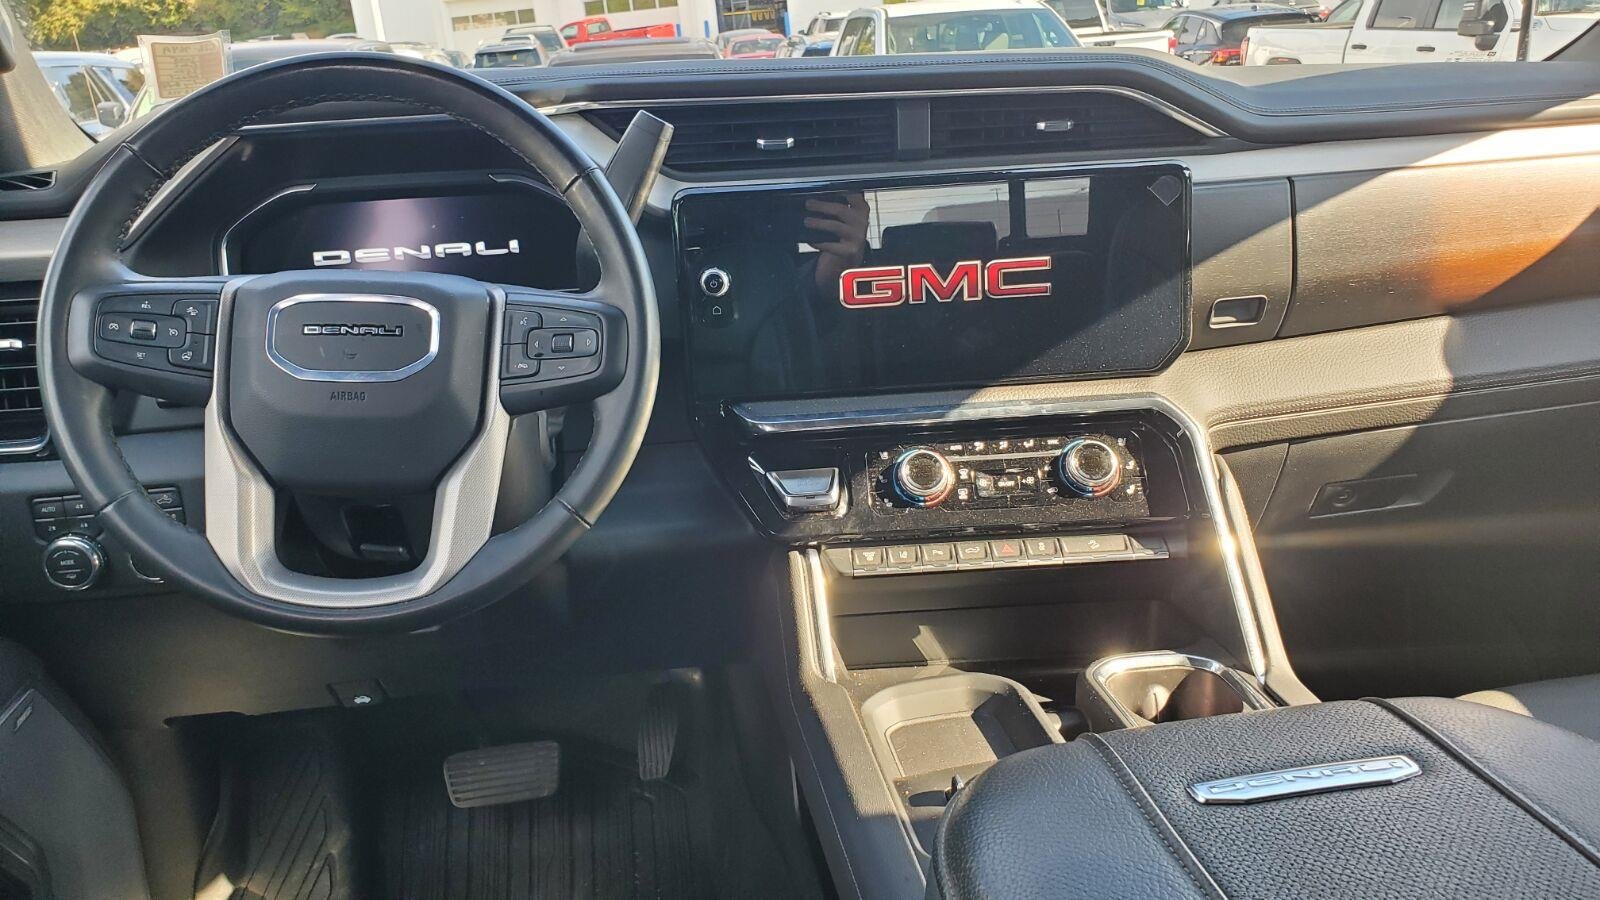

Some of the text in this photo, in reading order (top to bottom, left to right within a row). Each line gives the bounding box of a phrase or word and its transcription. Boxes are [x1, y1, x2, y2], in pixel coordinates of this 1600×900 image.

[312, 239, 520, 267] DENALI
[839, 255, 1052, 309] GMC
[303, 324, 403, 337] DENALI
[330, 391, 366, 401] AIRBAG
[1208, 760, 1404, 795] DENALI
